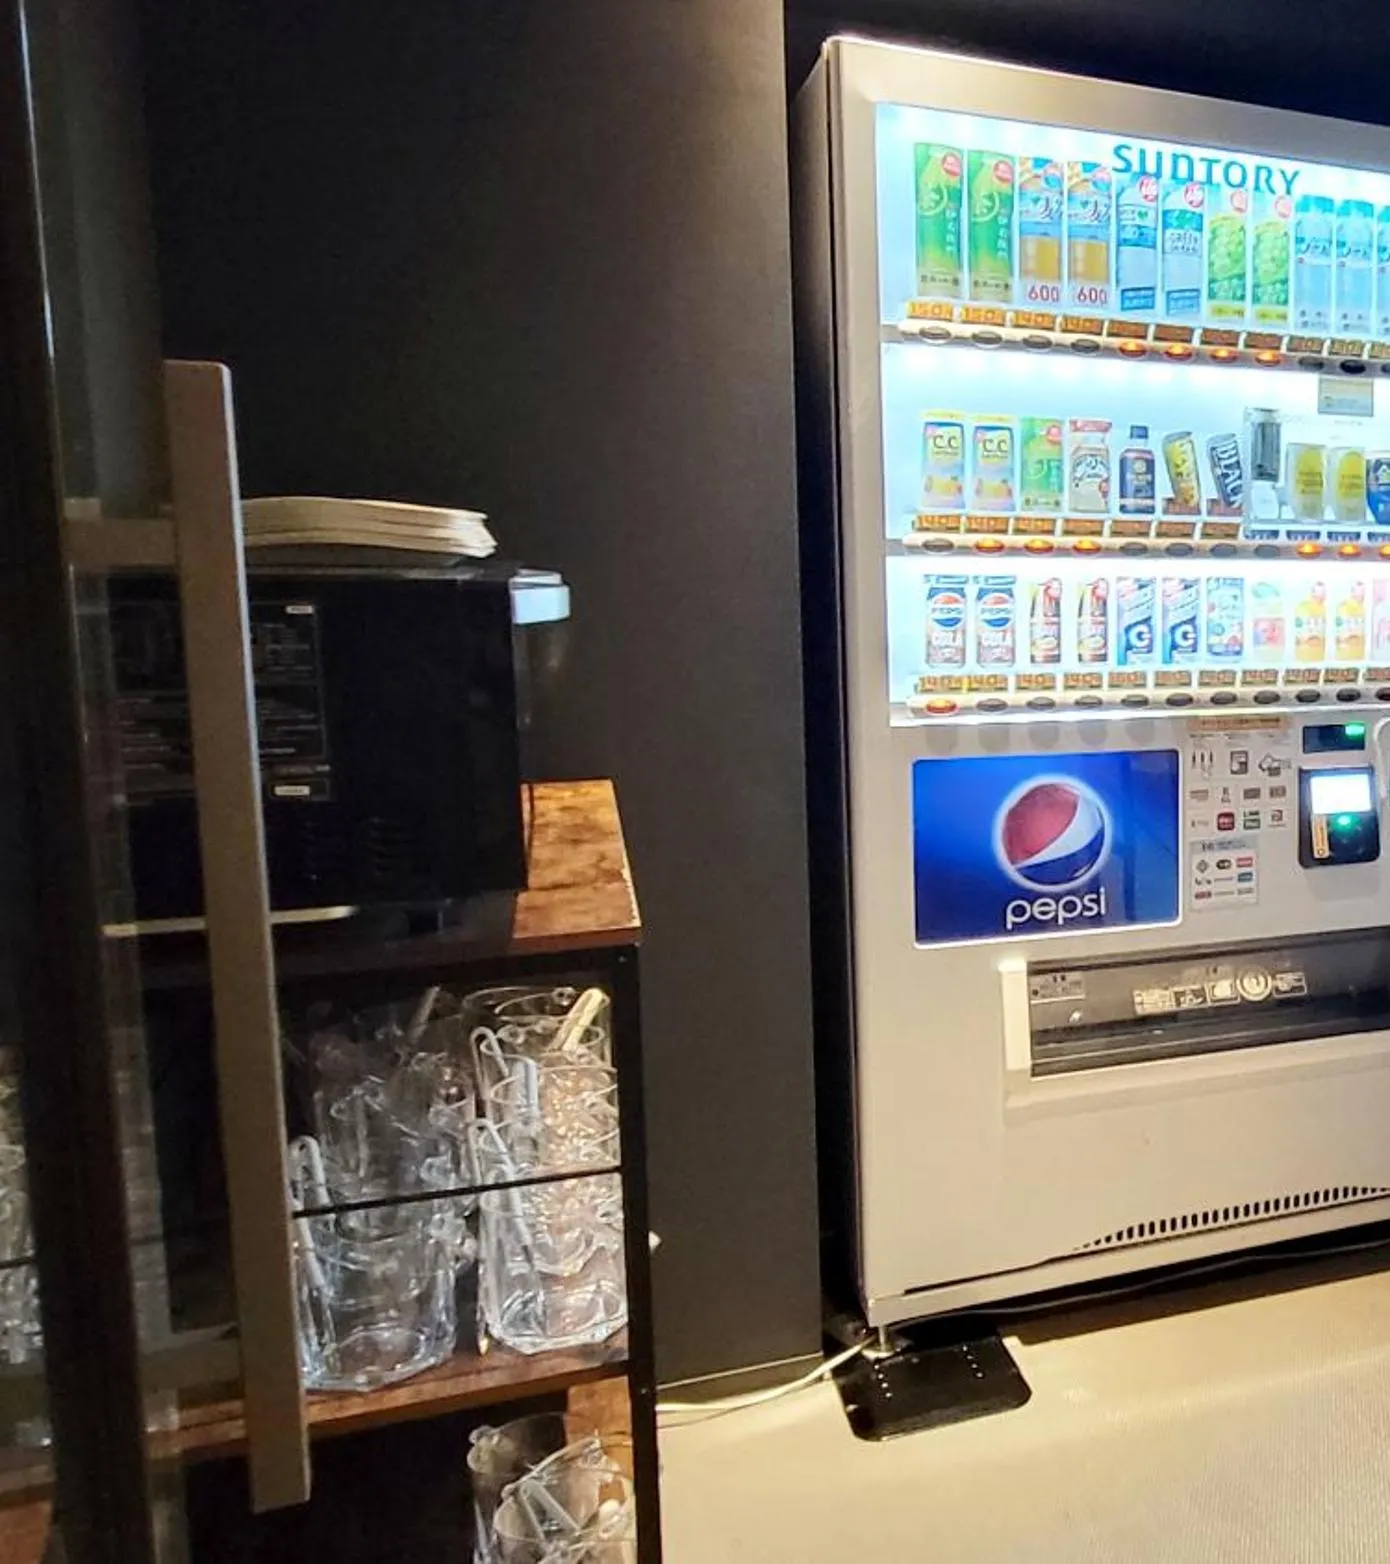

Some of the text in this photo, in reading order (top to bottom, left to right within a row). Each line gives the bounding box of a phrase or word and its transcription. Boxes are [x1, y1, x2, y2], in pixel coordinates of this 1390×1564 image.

[1112, 143, 1300, 196] SUNTORY
[1028, 285, 1060, 302] 600
[1078, 286, 1107, 304] 600
[1006, 886, 1106, 930] pepsi
